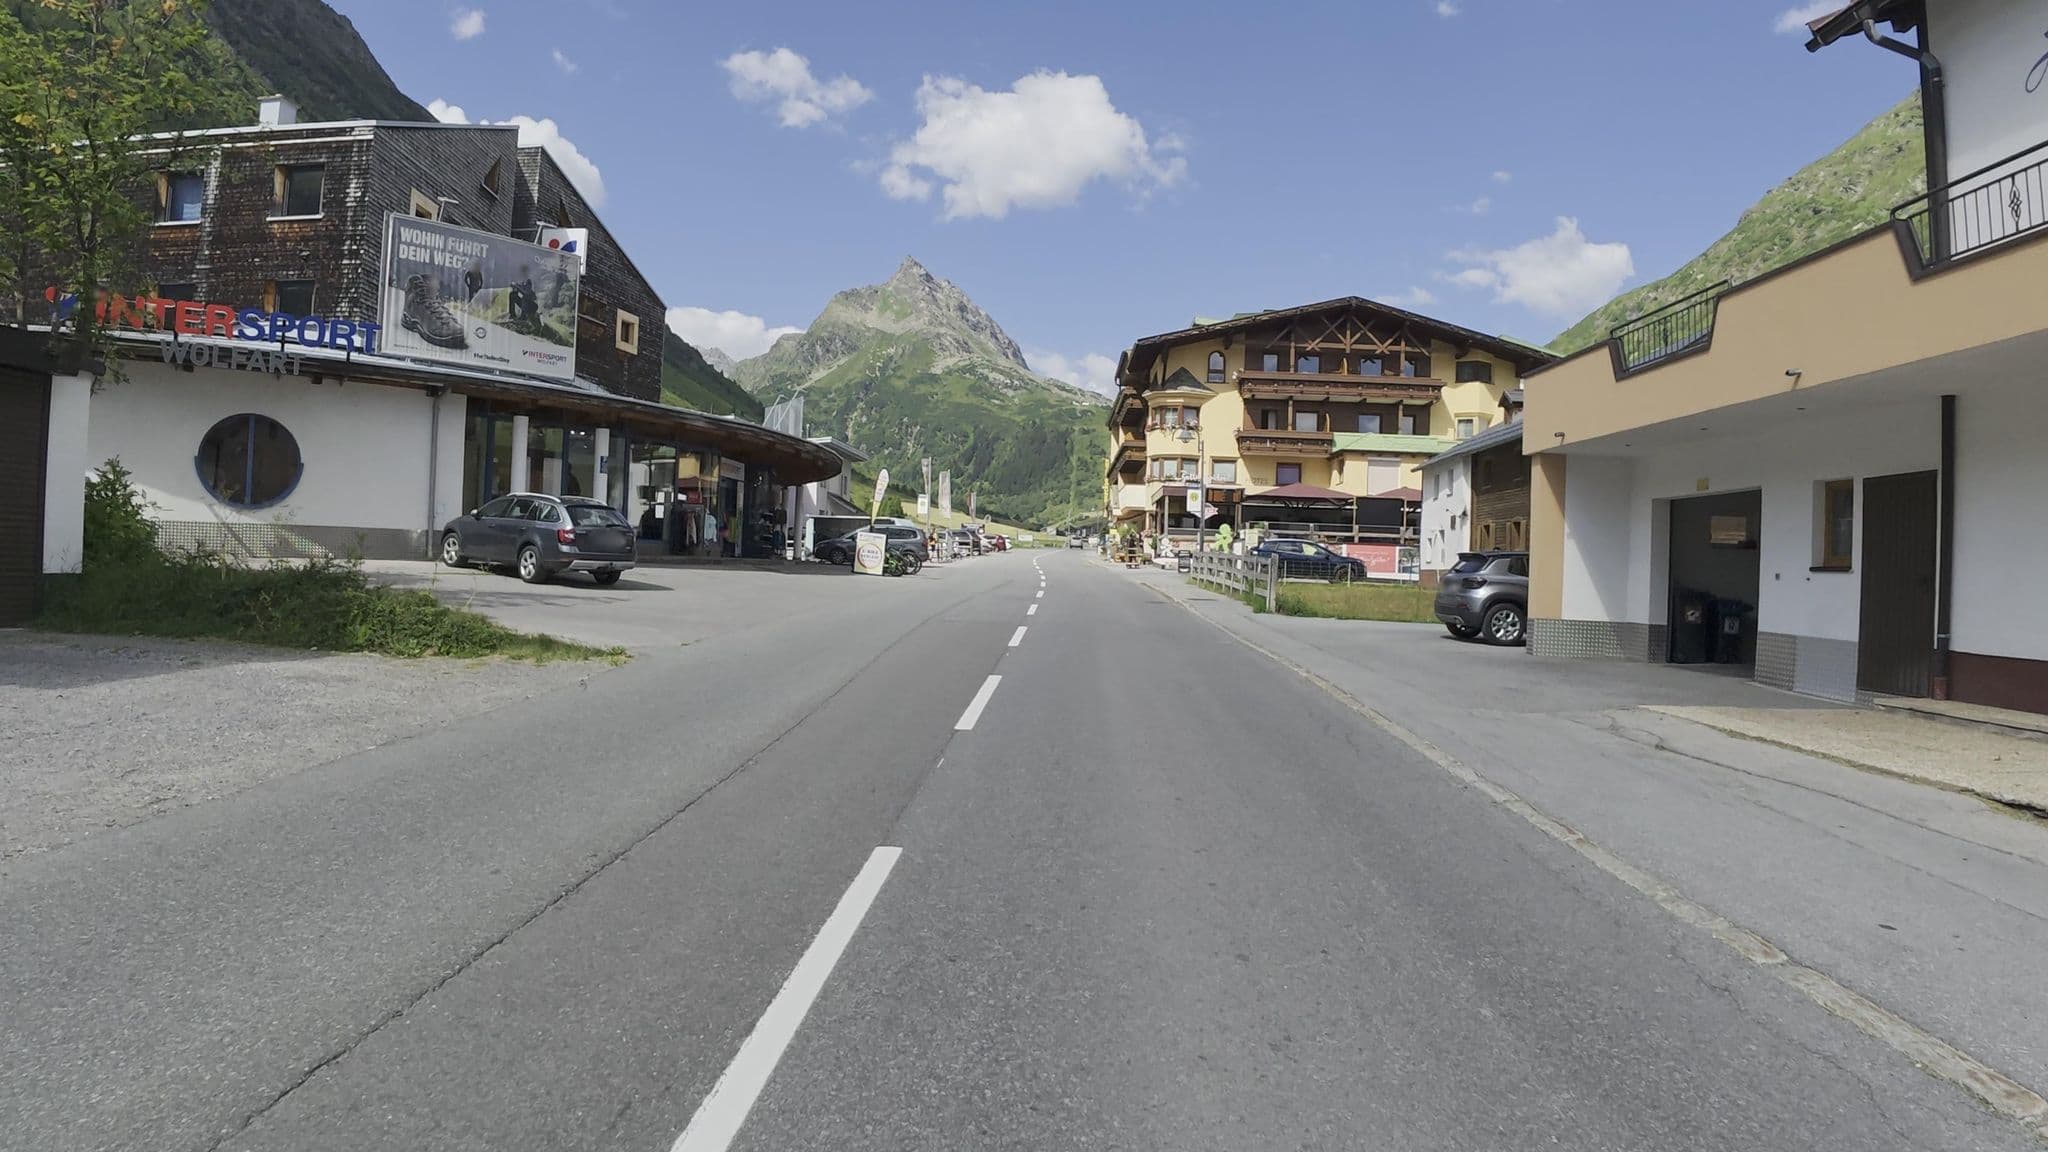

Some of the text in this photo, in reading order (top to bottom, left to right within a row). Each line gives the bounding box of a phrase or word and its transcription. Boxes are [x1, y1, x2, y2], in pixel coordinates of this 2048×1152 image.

[398, 243, 470, 271] DEIN WEG?
[400, 226, 489, 258] WOHIN FÜHRT
[95, 290, 382, 354] INTERSPORT
[160, 338, 307, 376] WOLFART
[528, 350, 567, 363] INTERSPORT
